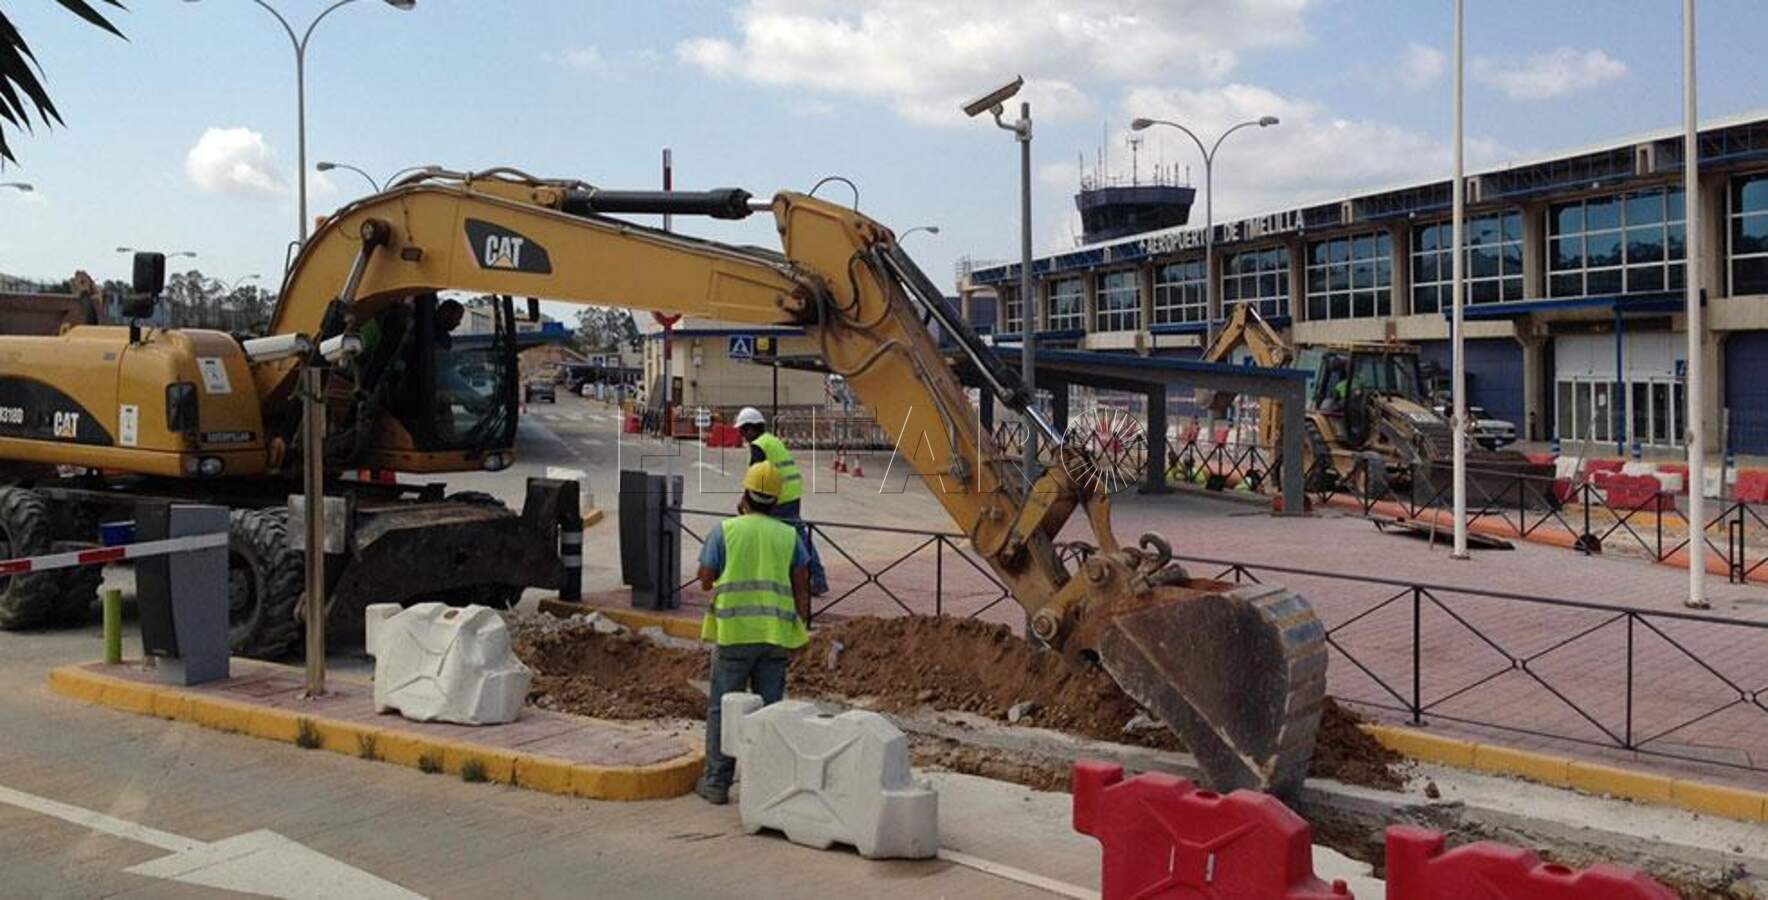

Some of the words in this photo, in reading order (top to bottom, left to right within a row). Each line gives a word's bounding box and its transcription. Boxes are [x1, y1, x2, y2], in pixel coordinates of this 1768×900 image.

[1223, 222, 1240, 243] DE
[485, 234, 524, 268] CAT
[53, 411, 79, 438] CAT
